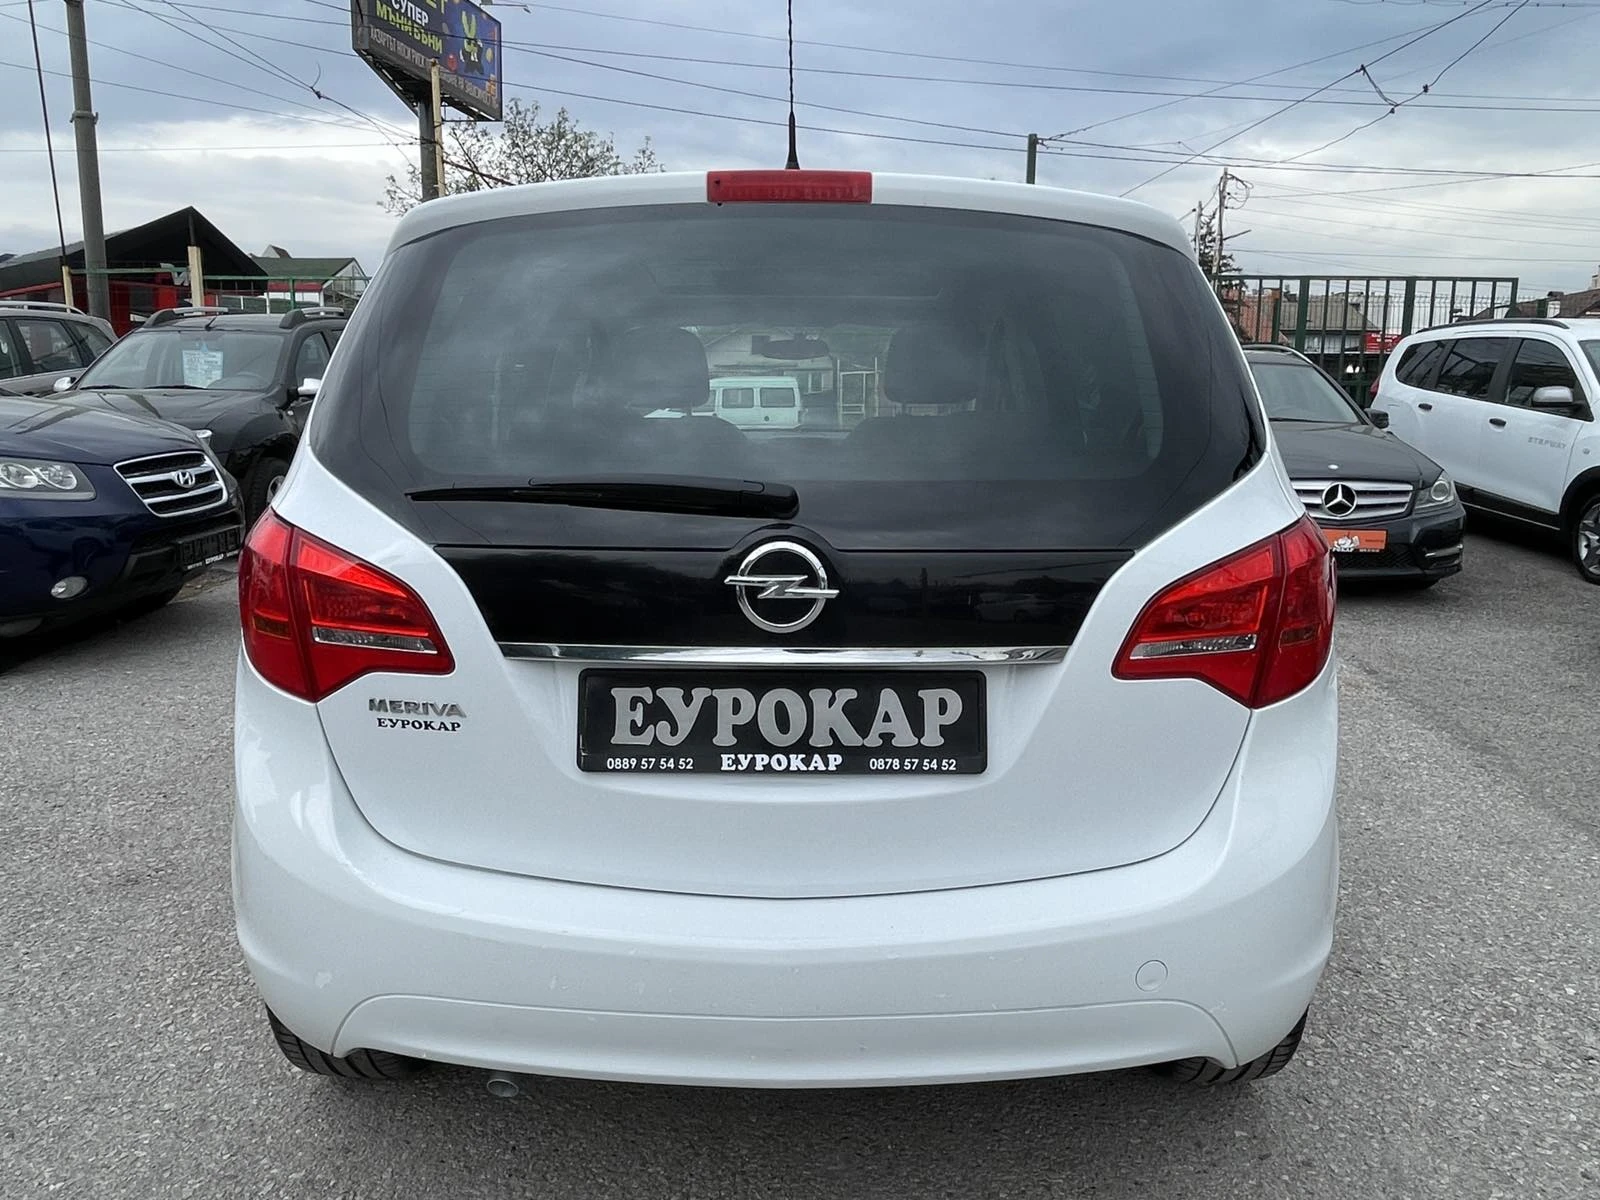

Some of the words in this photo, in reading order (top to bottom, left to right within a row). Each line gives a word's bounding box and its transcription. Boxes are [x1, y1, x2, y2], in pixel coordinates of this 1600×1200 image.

[392, 0, 429, 26] СУПЕР
[368, 698, 467, 718] MERIVA
[377, 718, 461, 732] ЕУРОКАР
[610, 687, 963, 748] ЕУРОКАР
[606, 758, 637, 770] 0889
[640, 758, 656, 770] 57
[659, 758, 675, 770] 54
[678, 758, 694, 770] 52
[720, 754, 843, 771] ЕУРОКАР
[869, 758, 900, 770] 0878
[903, 758, 919, 770] 57
[922, 758, 938, 770] 54
[941, 758, 957, 770] 52
